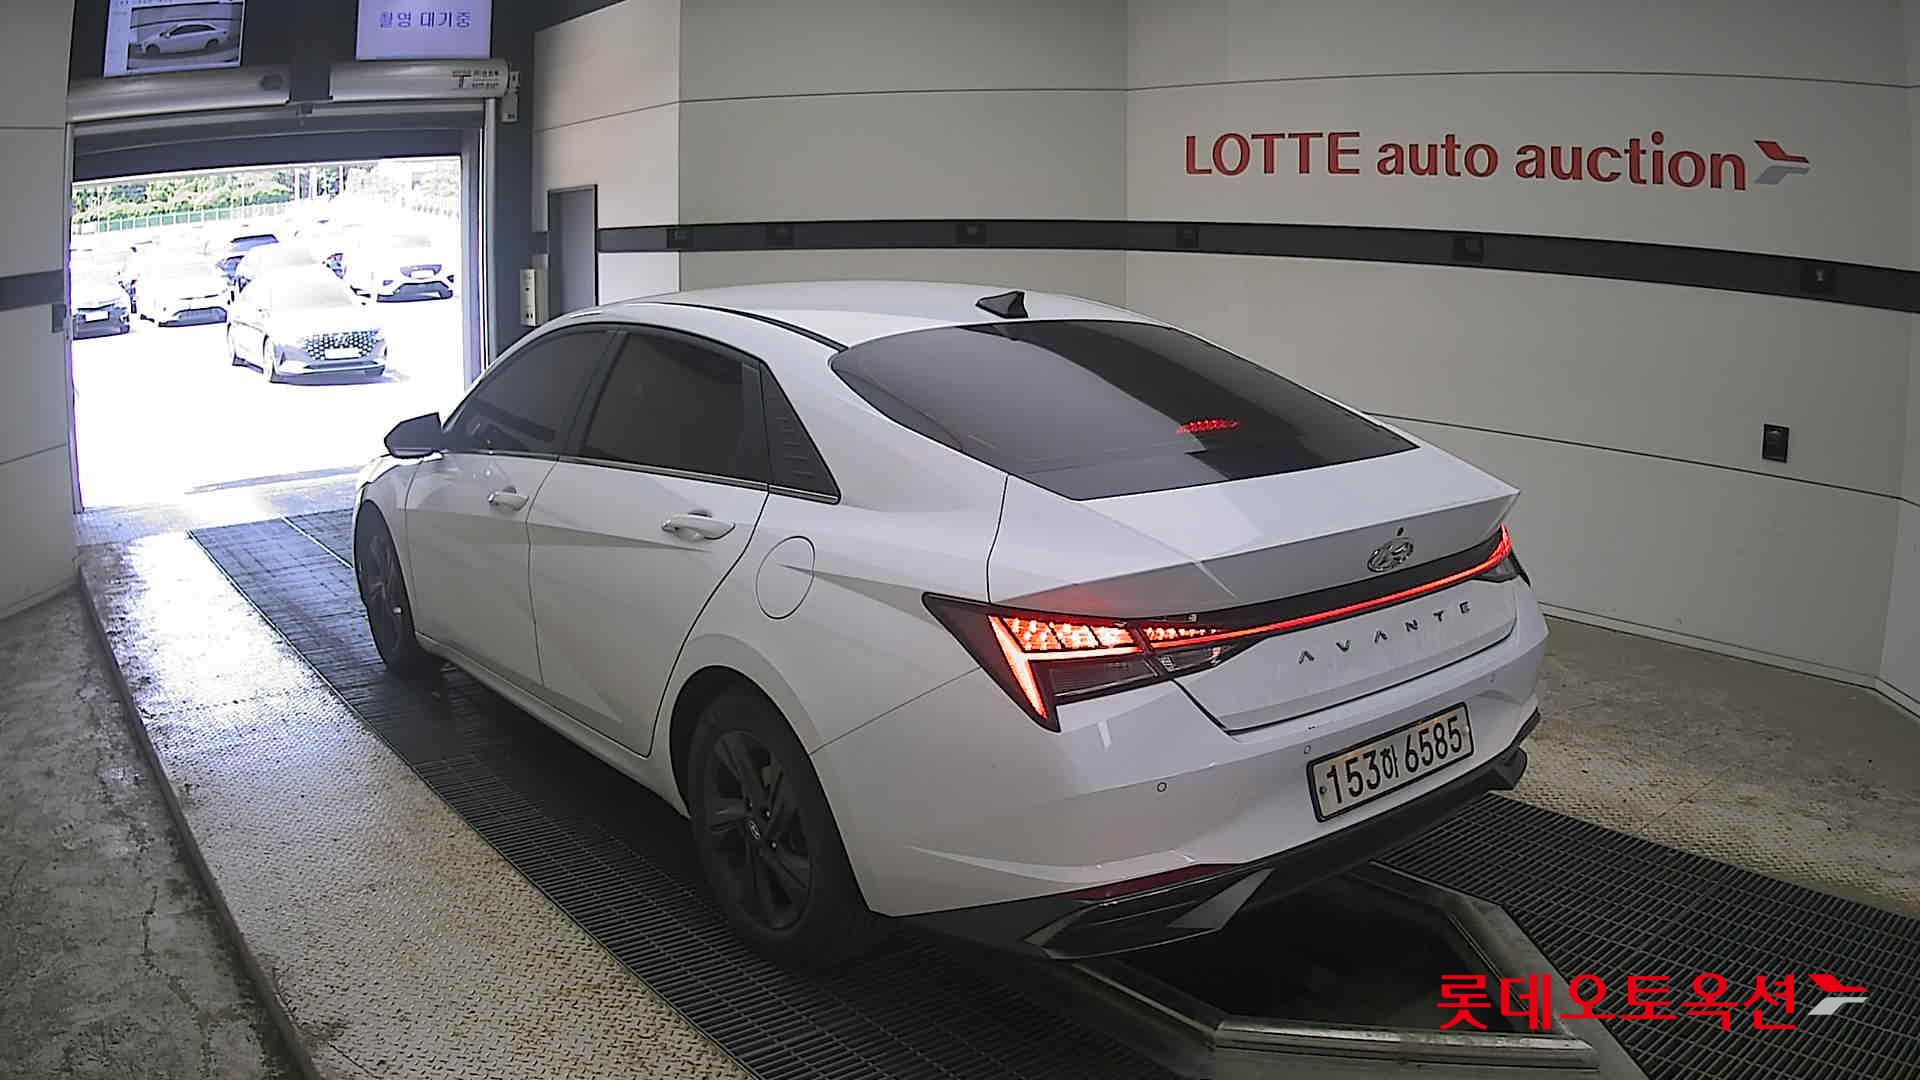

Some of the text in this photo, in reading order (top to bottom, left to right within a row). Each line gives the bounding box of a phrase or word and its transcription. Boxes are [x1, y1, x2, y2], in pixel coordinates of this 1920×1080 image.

[420, 10, 471, 29] 대기중
[1185, 131, 1747, 191] LOTTE auto auction
[1298, 601, 1472, 665] AVANTE
